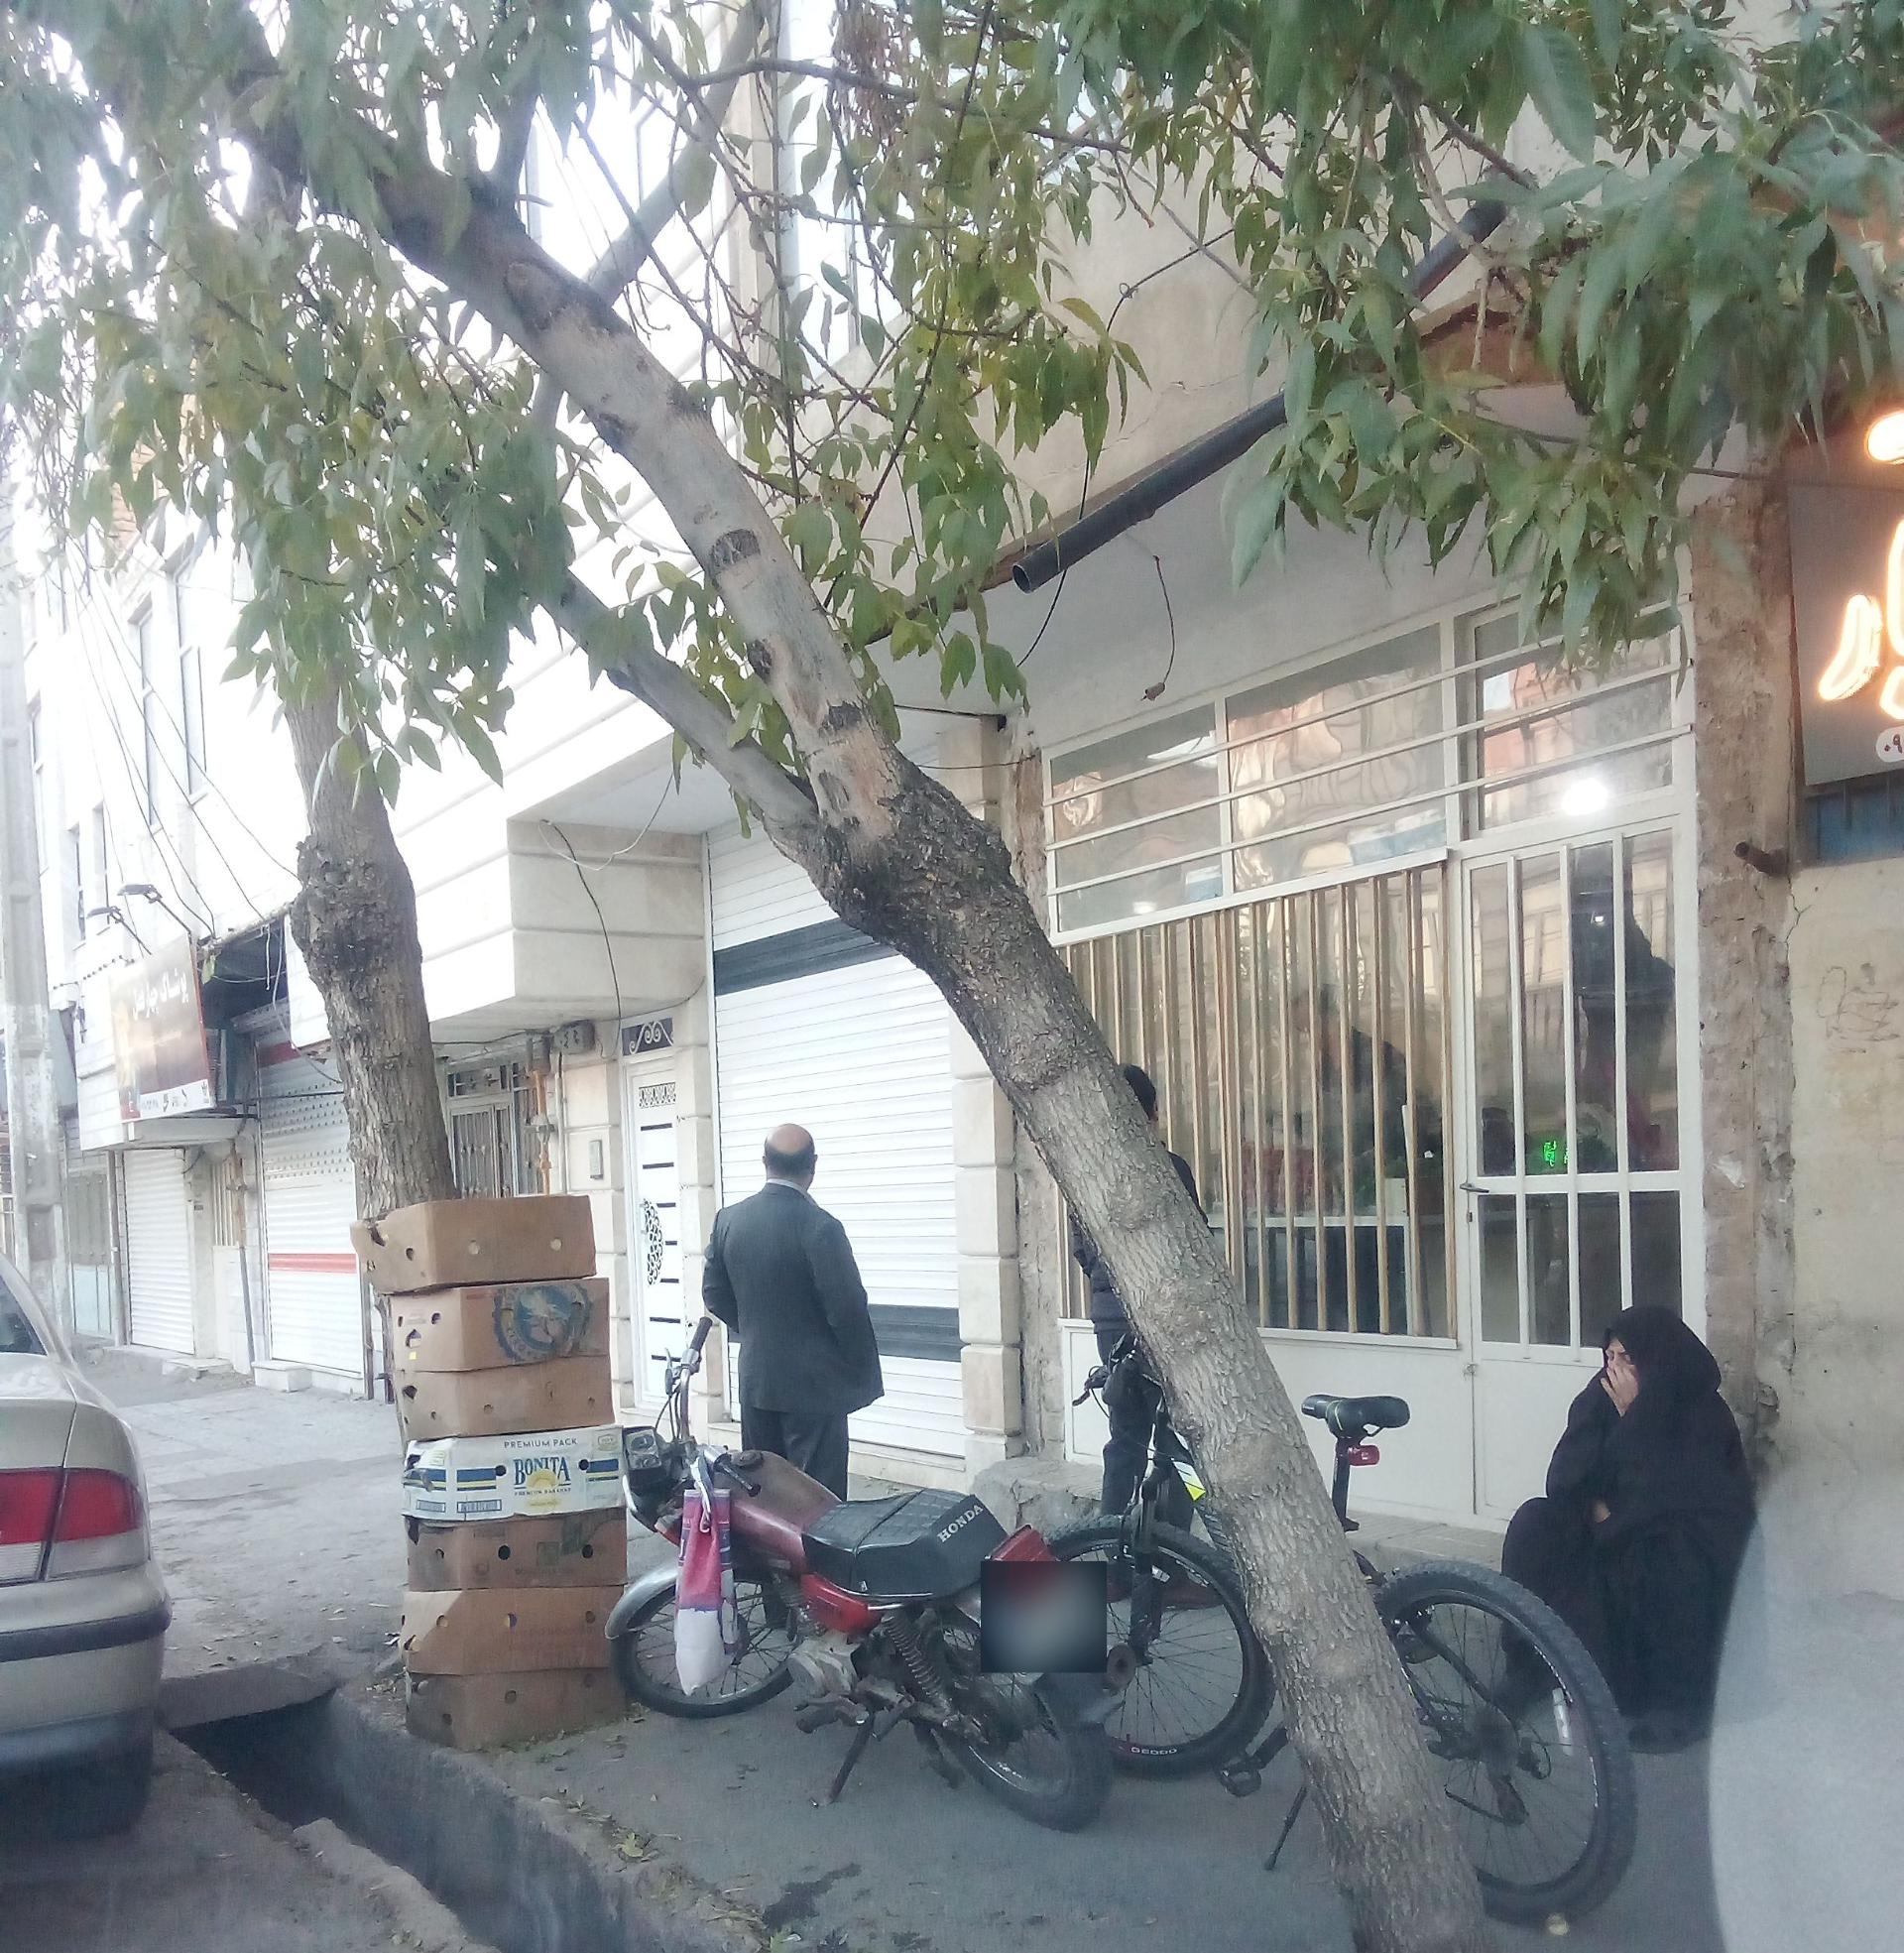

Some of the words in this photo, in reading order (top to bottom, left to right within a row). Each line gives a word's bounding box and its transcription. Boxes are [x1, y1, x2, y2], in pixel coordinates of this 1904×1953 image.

[504, 1439, 550, 1448] PREMIUM
[552, 1438, 577, 1447] PACK
[513, 1456, 571, 1486] BONITA
[937, 1505, 983, 1542] HONDA
